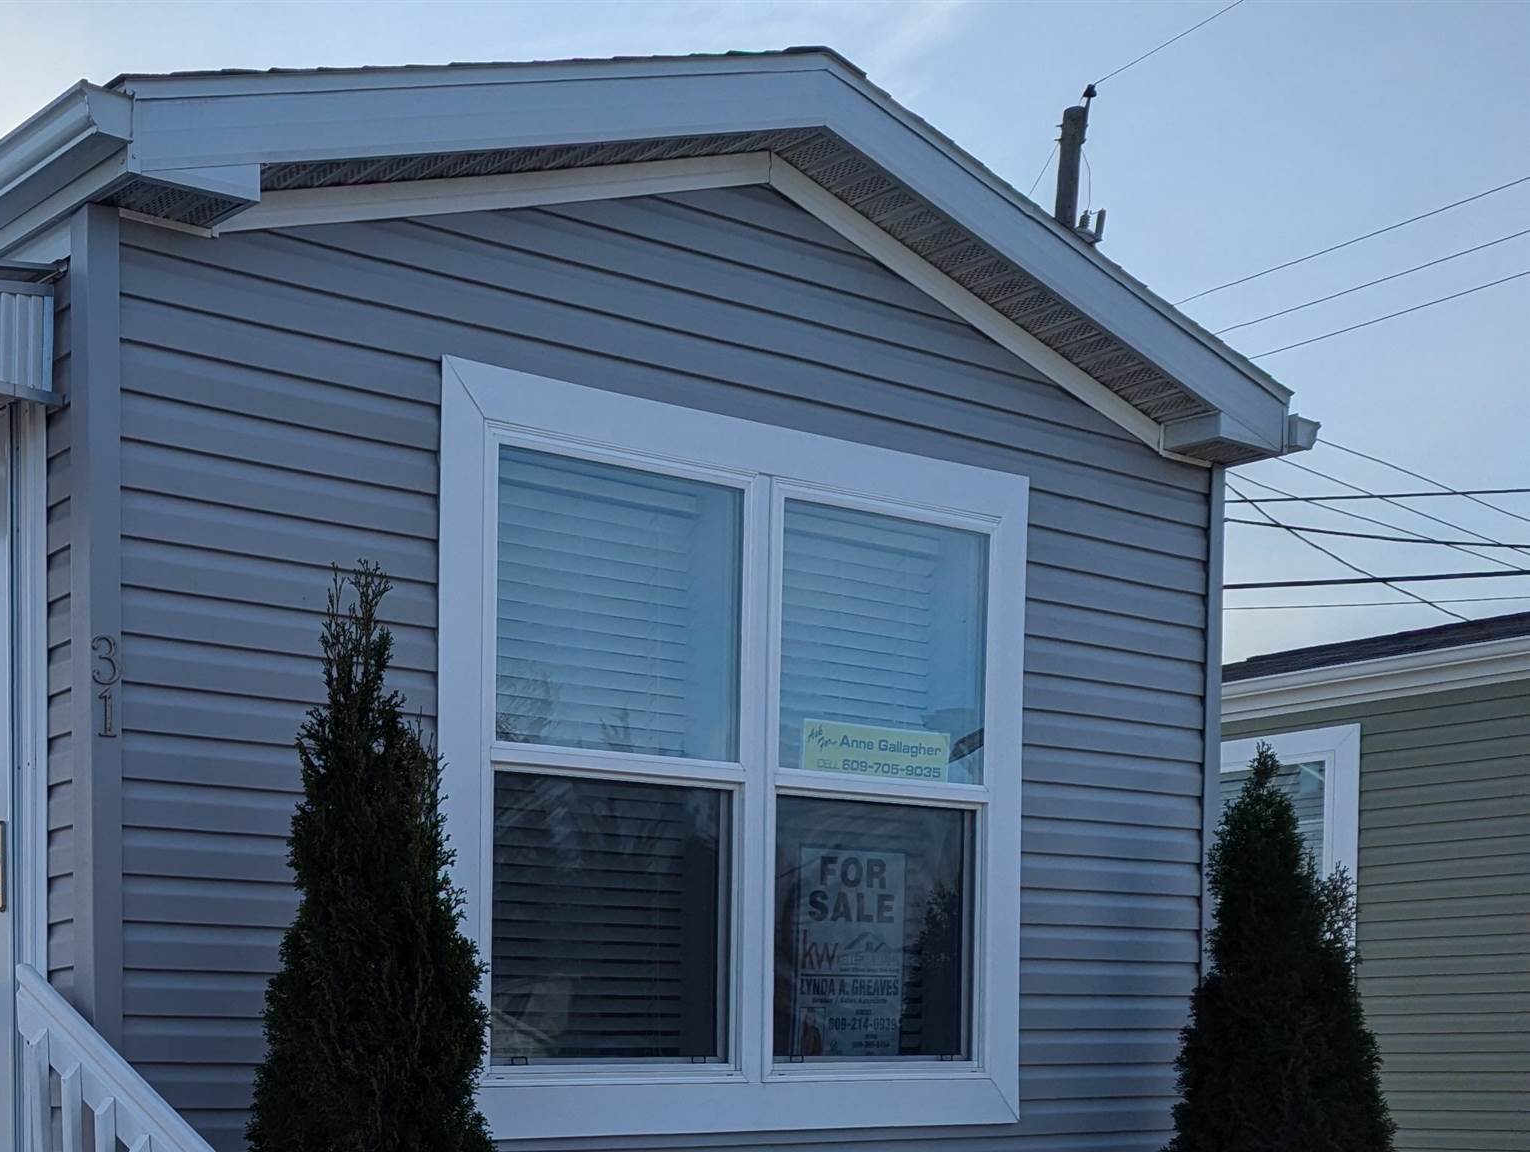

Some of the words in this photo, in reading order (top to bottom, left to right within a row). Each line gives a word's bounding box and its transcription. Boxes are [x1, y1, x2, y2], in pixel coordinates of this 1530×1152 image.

[91, 635, 120, 738] 31
[839, 735, 874, 750] Anne
[878, 739, 941, 757] Gallagher
[817, 758, 839, 769] CELL
[842, 760, 941, 778] 609-705-9035
[820, 856, 887, 889] FOR
[808, 890, 895, 923] SALE
[801, 929, 839, 970] kw
[800, 977, 835, 996] LYNDA
[852, 979, 899, 996] GREAVES
